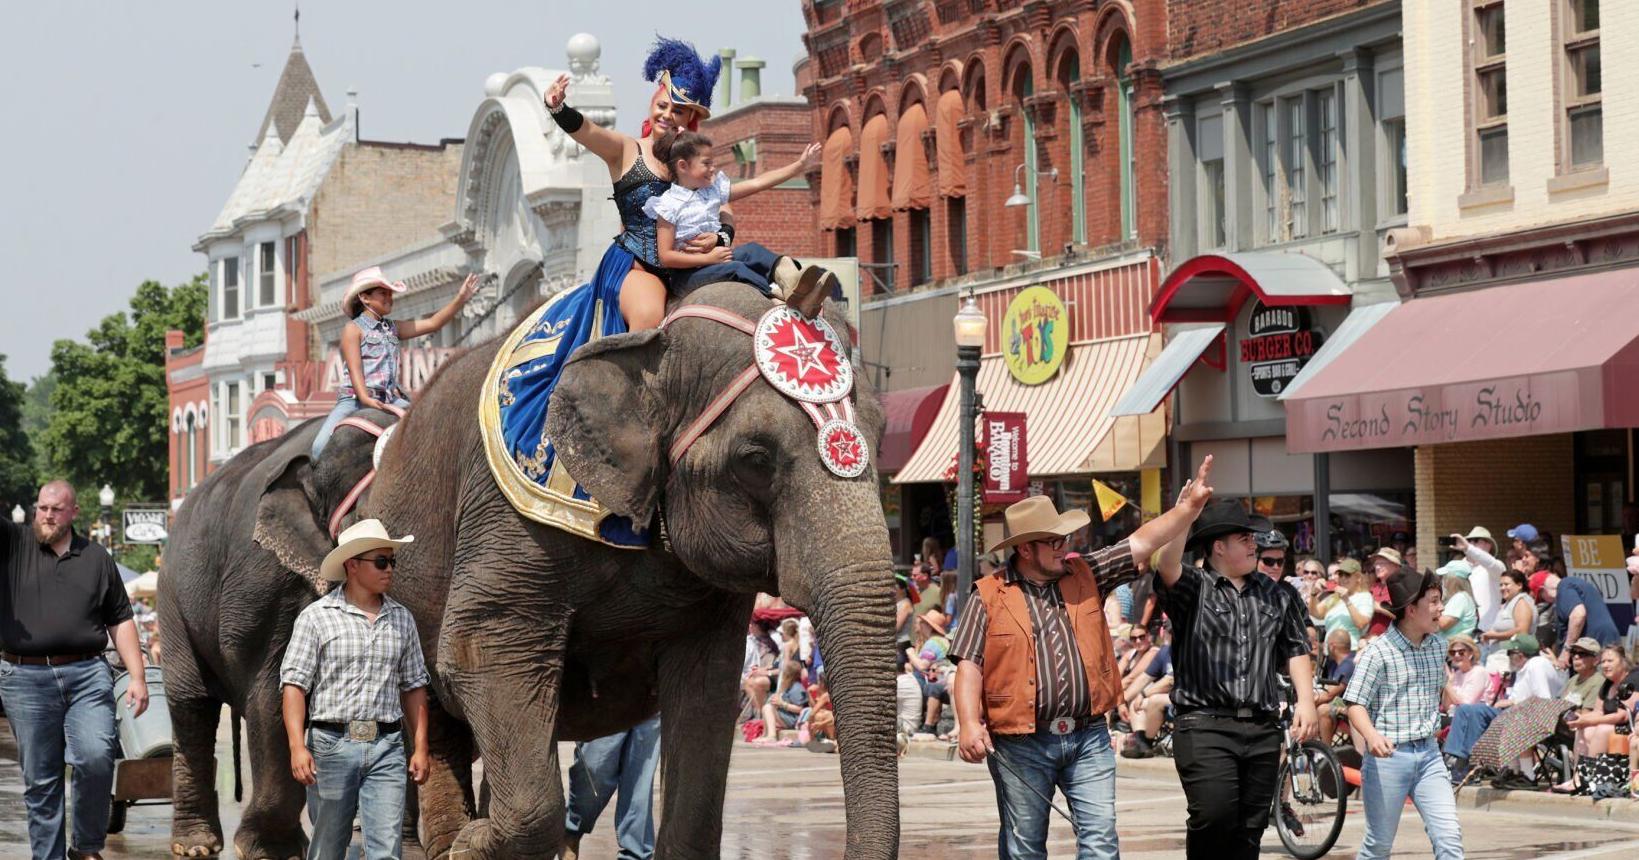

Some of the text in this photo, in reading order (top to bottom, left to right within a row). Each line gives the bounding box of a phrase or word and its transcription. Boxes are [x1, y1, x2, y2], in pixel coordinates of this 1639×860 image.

[1240, 334, 1292, 363] BURGER
[1322, 385, 1541, 441] Second Story Studio
[1000, 432, 1011, 490] Downtown
[1011, 426, 1020, 471] Welcome to
[1578, 538, 1601, 566] BE
[1573, 572, 1619, 599] ND
